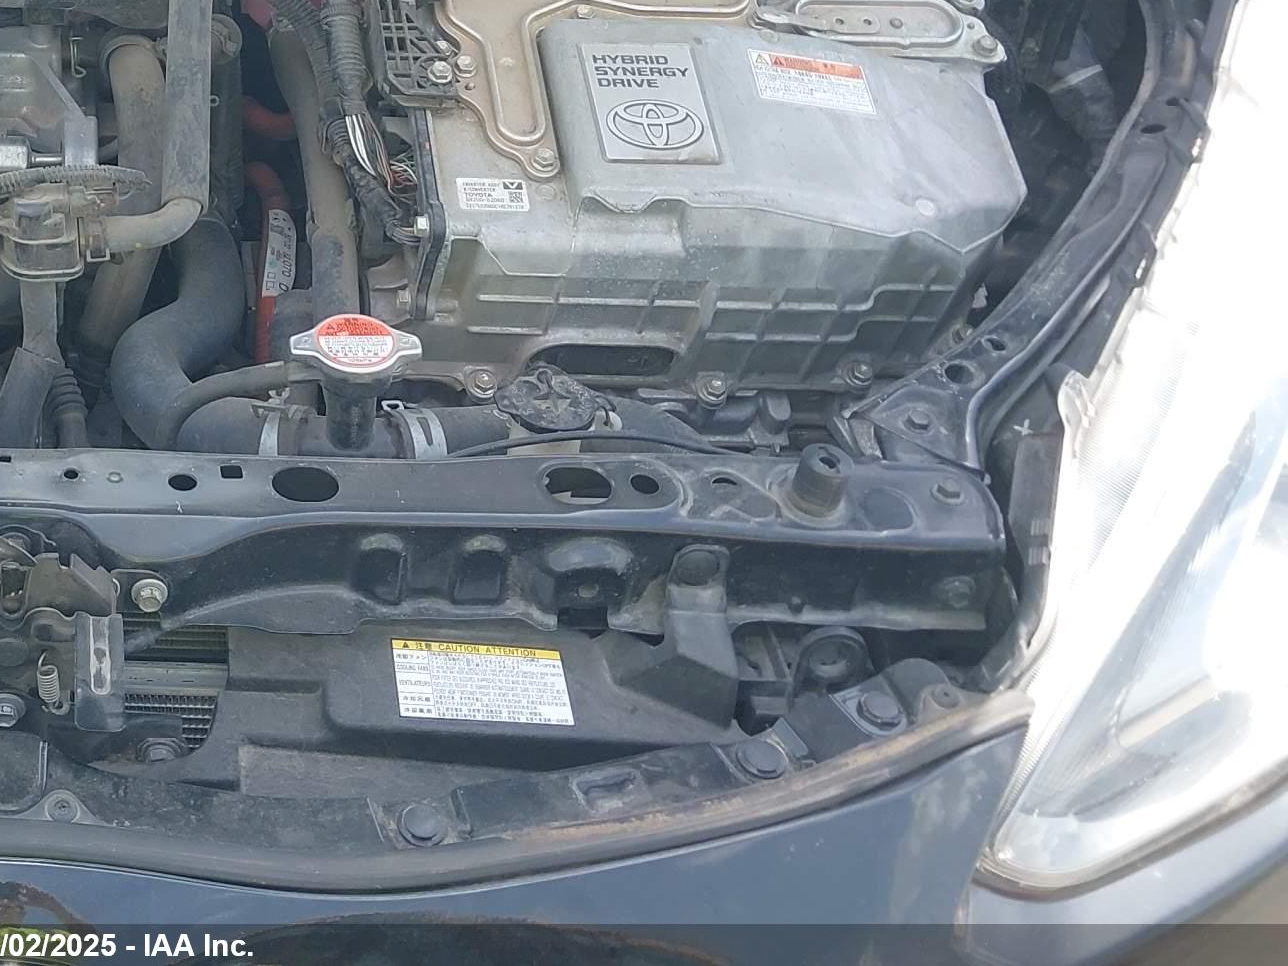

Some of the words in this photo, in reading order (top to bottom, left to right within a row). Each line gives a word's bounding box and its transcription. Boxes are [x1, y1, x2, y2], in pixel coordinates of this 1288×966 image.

[592, 54, 669, 65] HYBRID
[594, 66, 689, 77] SYNERGY
[597, 78, 660, 89] DRIVE
[438, 643, 480, 653] CAUTION
[485, 647, 536, 657] ATTENTION
